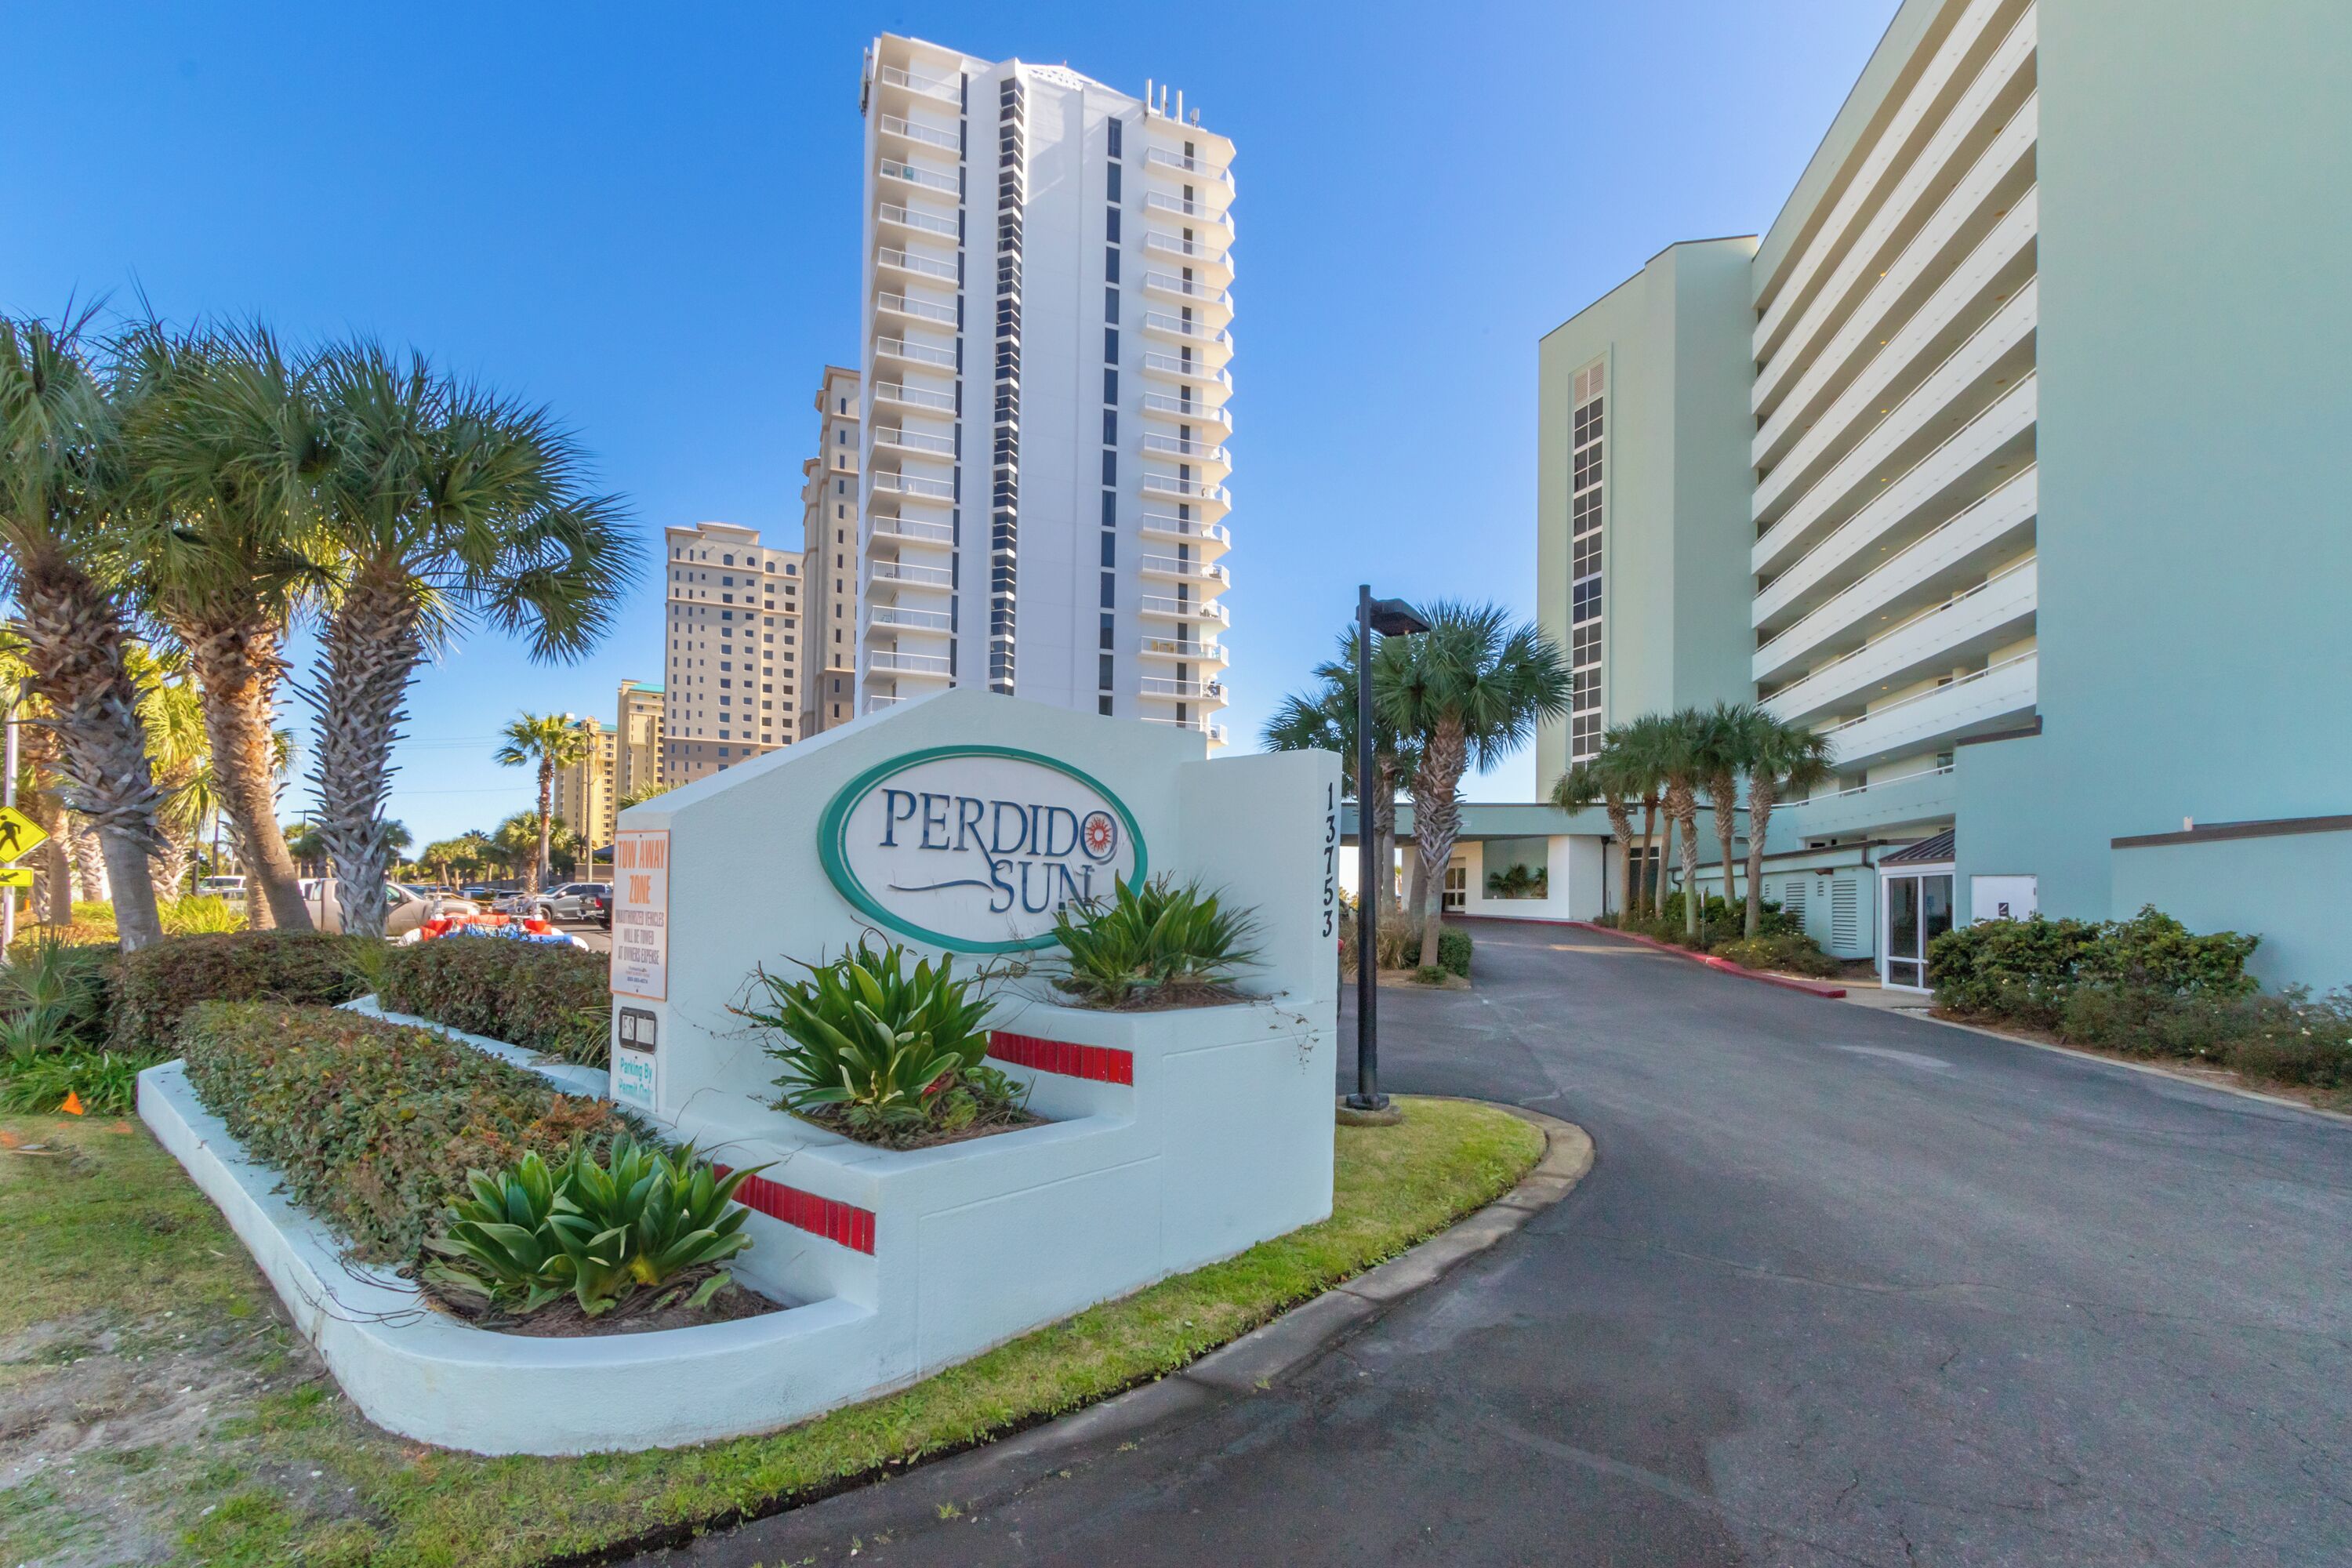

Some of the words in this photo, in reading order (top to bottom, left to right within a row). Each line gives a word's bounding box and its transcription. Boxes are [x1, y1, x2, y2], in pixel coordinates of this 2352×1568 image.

[879, 788, 1118, 866] PERDIDO
[618, 840, 637, 869] TOW
[639, 840, 666, 869] AWAY
[1322, 782, 1336, 938] 13753
[629, 874, 651, 904] ZONE
[989, 859, 1095, 915] SUN
[645, 911, 665, 927] VEHICLES
[624, 928, 633, 943] WILL
[634, 929, 640, 944] BE
[641, 929, 654, 946] TOWED
[618, 946, 623, 960] AT
[641, 948, 659, 965] EXPENSE
[620, 1057, 643, 1082] Parking
[644, 1062, 652, 1084] By
